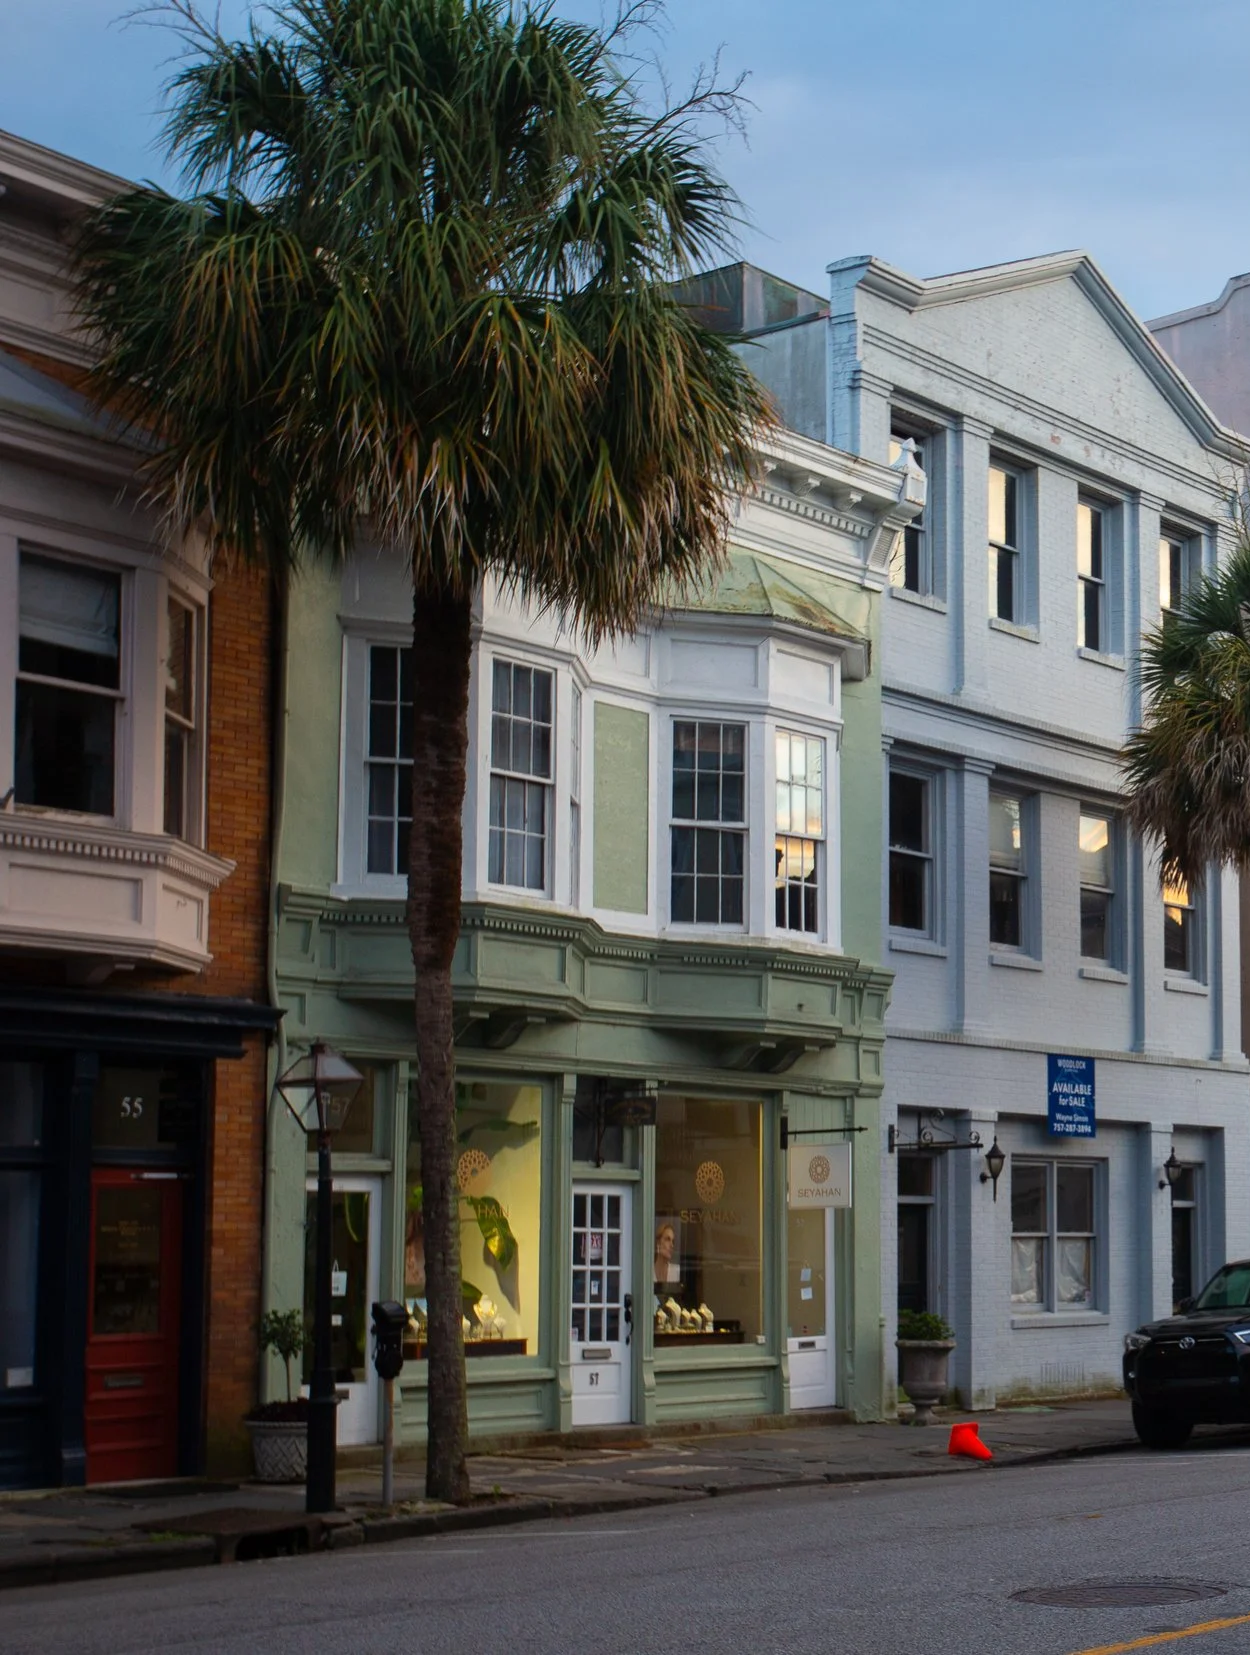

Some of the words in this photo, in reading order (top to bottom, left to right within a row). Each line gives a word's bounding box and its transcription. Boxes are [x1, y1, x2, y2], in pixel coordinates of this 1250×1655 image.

[1052, 1082, 1092, 1095] AVAILABLE
[120, 1096, 142, 1118] 55
[1058, 1095, 1068, 1106] for
[1069, 1096, 1086, 1107] SALE
[797, 1188, 842, 1198] SEYAHAN
[680, 1210, 739, 1223] SEYAHAN
[589, 1372, 599, 1386] 57
